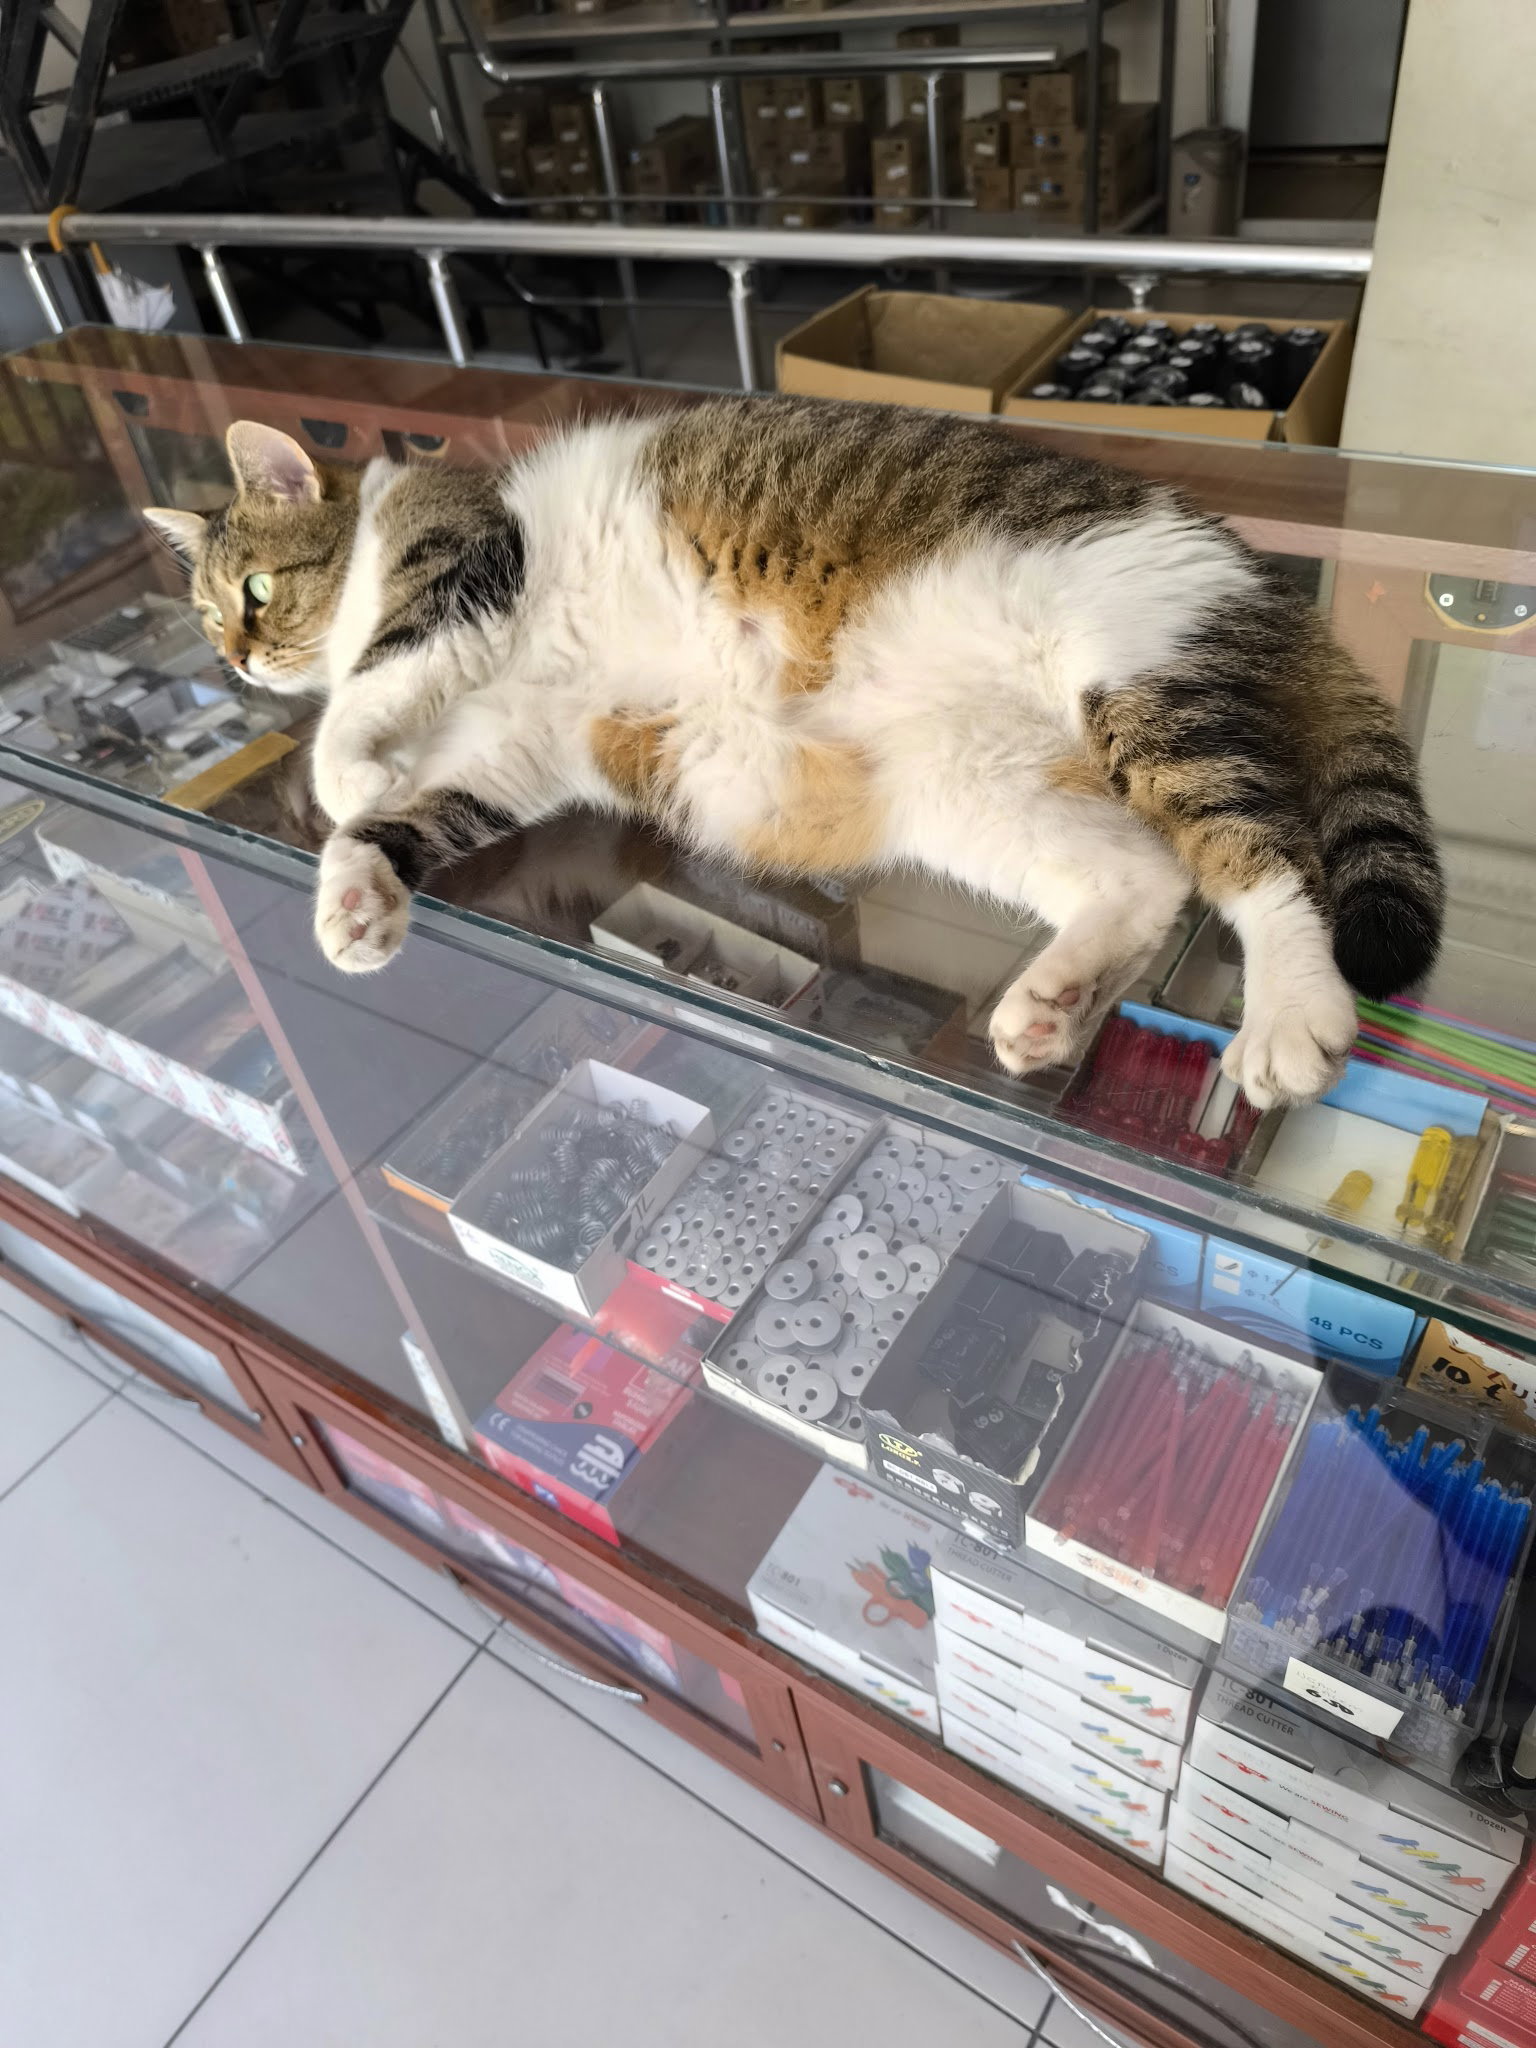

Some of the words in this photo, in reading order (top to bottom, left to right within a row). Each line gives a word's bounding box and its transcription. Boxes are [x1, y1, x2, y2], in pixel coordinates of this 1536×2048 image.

[1310, 1316, 1333, 1331] 48
[1340, 1327, 1384, 1351] PCS
[1221, 1676, 1277, 1710] TC-801
[1216, 1692, 1254, 1717] THREAD
[1256, 1712, 1294, 1736] CUTTER
[1311, 1799, 1350, 1822] SEWING
[1477, 1814, 1506, 1833] Dozen
